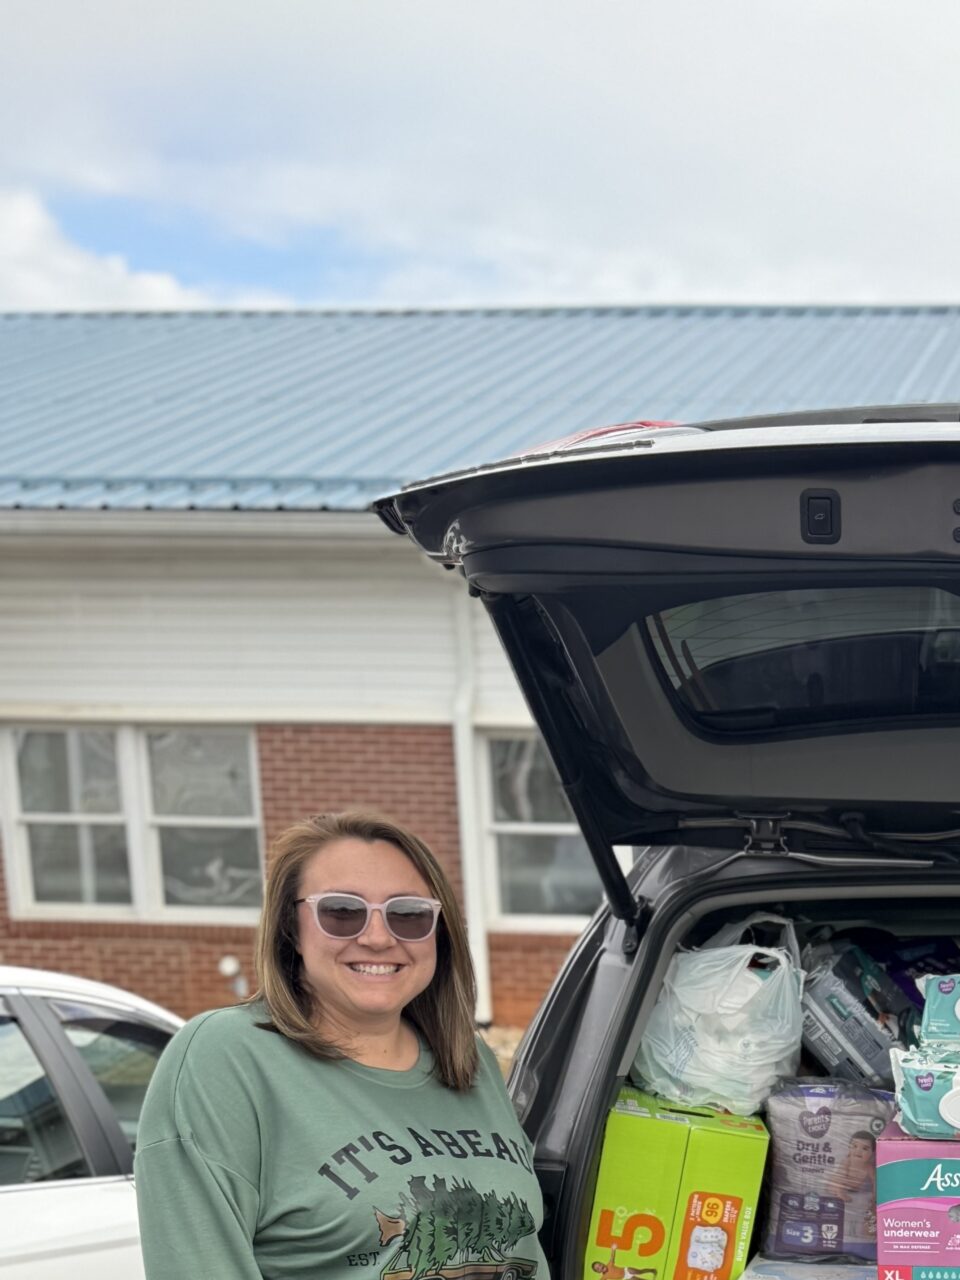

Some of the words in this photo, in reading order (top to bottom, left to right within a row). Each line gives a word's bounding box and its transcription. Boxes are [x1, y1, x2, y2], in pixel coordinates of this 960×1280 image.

[795, 1141, 820, 1154] Dry
[823, 1141, 832, 1153] &
[318, 1130, 412, 1200] IT'S
[792, 1152, 836, 1165] Gentle
[704, 1202, 719, 1217] 96
[744, 1206, 753, 1220] BOX
[740, 1221, 750, 1240] VALUE
[883, 1218, 931, 1228] Women's
[595, 1208, 666, 1257] 5
[801, 1226, 814, 1243] 3
[884, 1229, 940, 1238] underwear
[347, 1251, 380, 1267] EST.
[736, 1242, 746, 1262] SUPER
